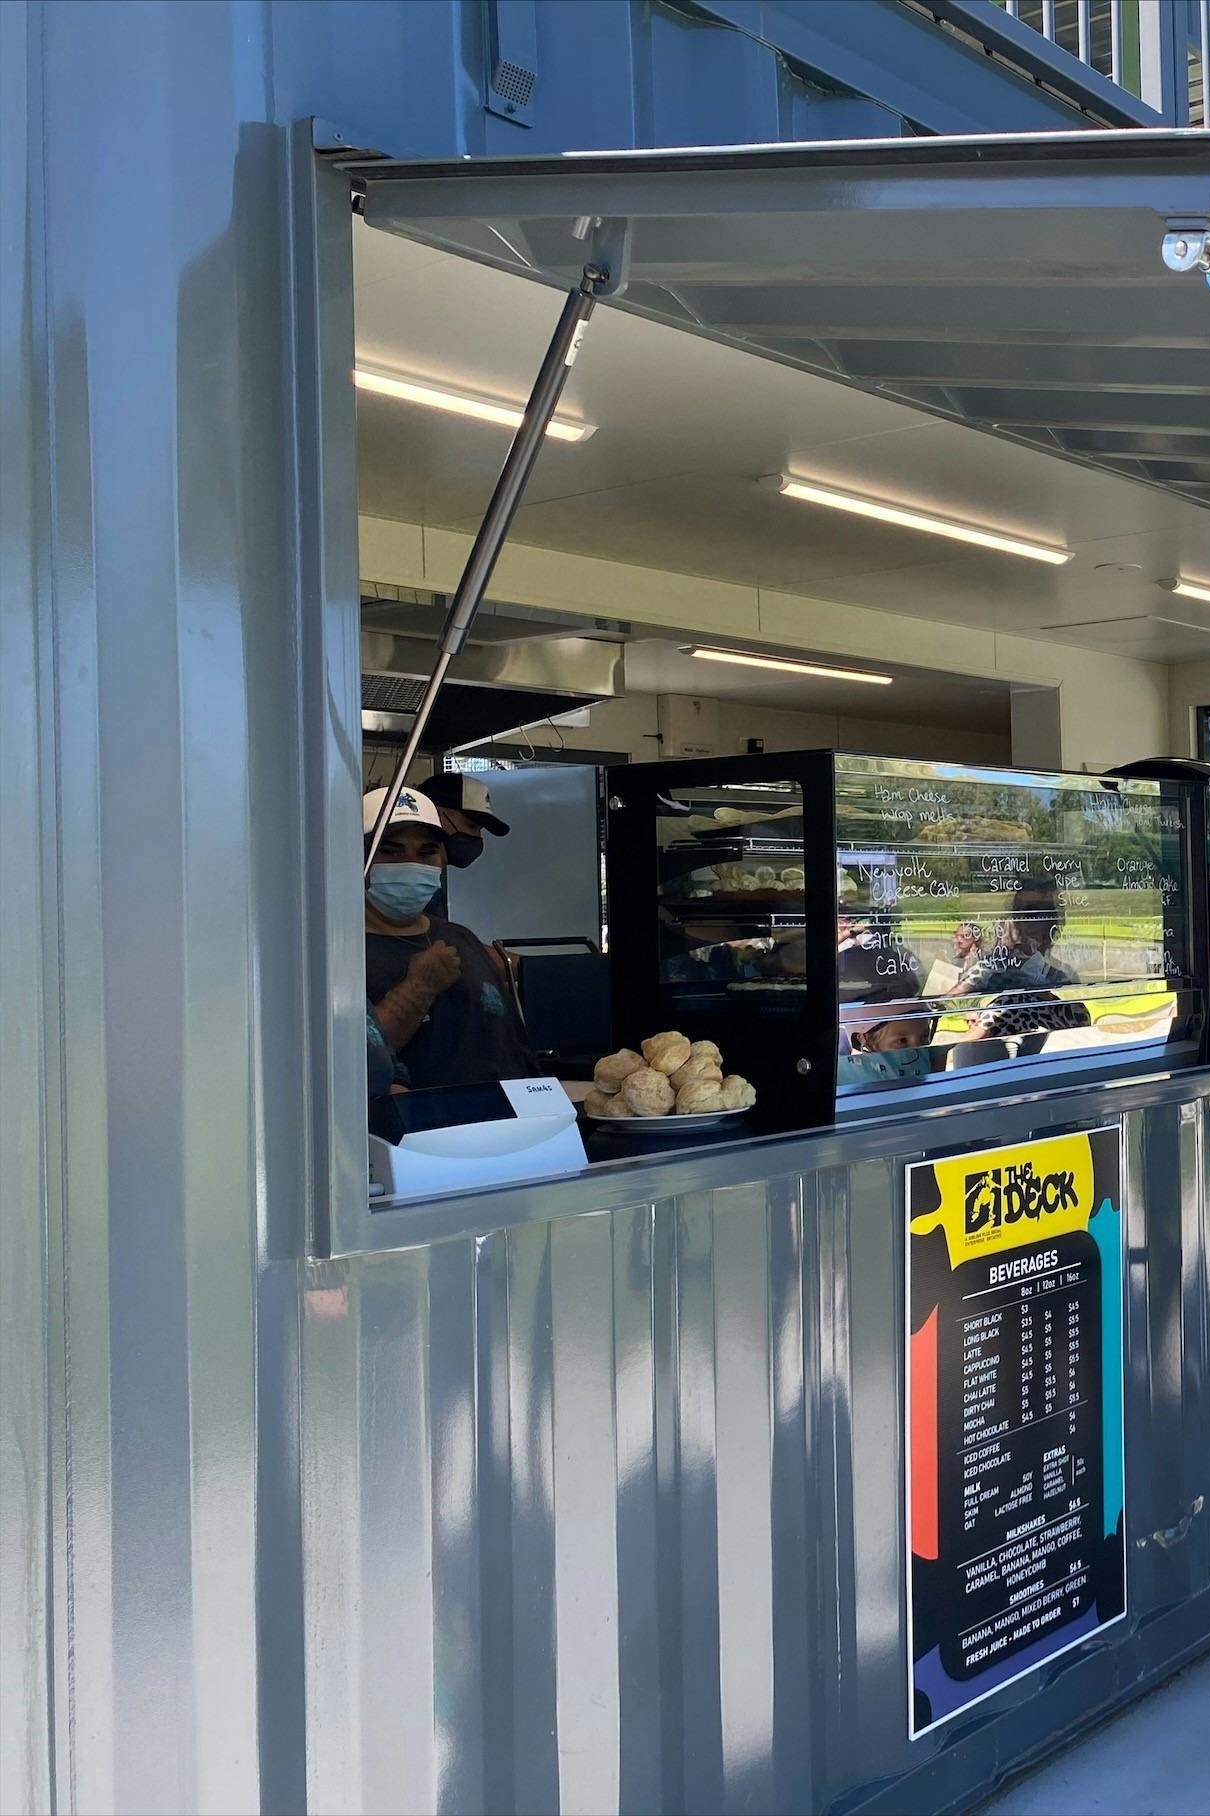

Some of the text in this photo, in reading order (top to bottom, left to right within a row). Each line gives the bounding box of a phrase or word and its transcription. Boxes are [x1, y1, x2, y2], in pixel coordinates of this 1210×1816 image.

[874, 783, 951, 803] Ham Cheese
[981, 852, 1029, 872] Caramel
[1043, 855, 1086, 888] Cherry
[1117, 857, 1154, 880] Orange
[1054, 873, 1081, 893] Ripe
[1122, 875, 1155, 890] Almond
[872, 880, 960, 908] Cheese Cake
[876, 946, 919, 975] Cake
[1005, 1161, 1033, 1187] THE
[1003, 1171, 1078, 1225] DECK
[990, 1250, 1058, 1284] BEVERAGES
[1021, 1273, 1079, 1296] 8oz 12oz 16oz
[964, 1319, 982, 1332] SHORT
[984, 1313, 1002, 1326] BLACK
[964, 1334, 979, 1346] LONG
[981, 1328, 999, 1341] BLACK
[964, 1347, 981, 1361] LATTE
[964, 1355, 999, 1375] CAPPUCCINO
[964, 1376, 978, 1389] FLAT
[979, 1369, 997, 1383] WHITE
[964, 1391, 978, 1403] CHAI
[979, 1384, 996, 1398] LATTE
[964, 1404, 980, 1417] DIRTY
[981, 1398, 994, 1410] CHAI
[964, 1416, 985, 1431] MOCHA
[964, 1433, 976, 1445] HOT
[976, 1420, 1009, 1440] CHOCOLATE
[964, 1452, 978, 1464] ICED
[979, 1442, 1000, 1459] COFFEE
[1044, 1445, 1065, 1462] EXTRAS
[964, 1466, 978, 1479] ICED
[979, 1452, 1011, 1472] CHOCOLATE
[1023, 1472, 1032, 1483] SOY
[964, 1482, 980, 1497] MILK
[964, 1487, 999, 1508] FULL CREAM
[1010, 1482, 1032, 1499] ALMOND
[965, 1507, 978, 1519] SKIM
[995, 1493, 1032, 1517] LACTOSE FREE
[965, 1519, 975, 1530] OAT
[1007, 1514, 1045, 1540] MILKSHAKES
[966, 1515, 1081, 1579] VANILLA, CHOCOLATE, STRAWBERRY,
[966, 1570, 1000, 1593] CARAMEL,
[1007, 1559, 1046, 1587] HONEYCOMB
[1010, 1580, 1044, 1605] SMOOTHIES
[1022, 1599, 1041, 1617] MIXED
[1065, 1575, 1086, 1593] GREEN
[966, 1647, 988, 1666] FRESH
[989, 1636, 1007, 1653] JUICE
[1014, 1623, 1031, 1640] MADE
[1032, 1619, 1040, 1629] TO
[1041, 1607, 1061, 1625] ORDER
